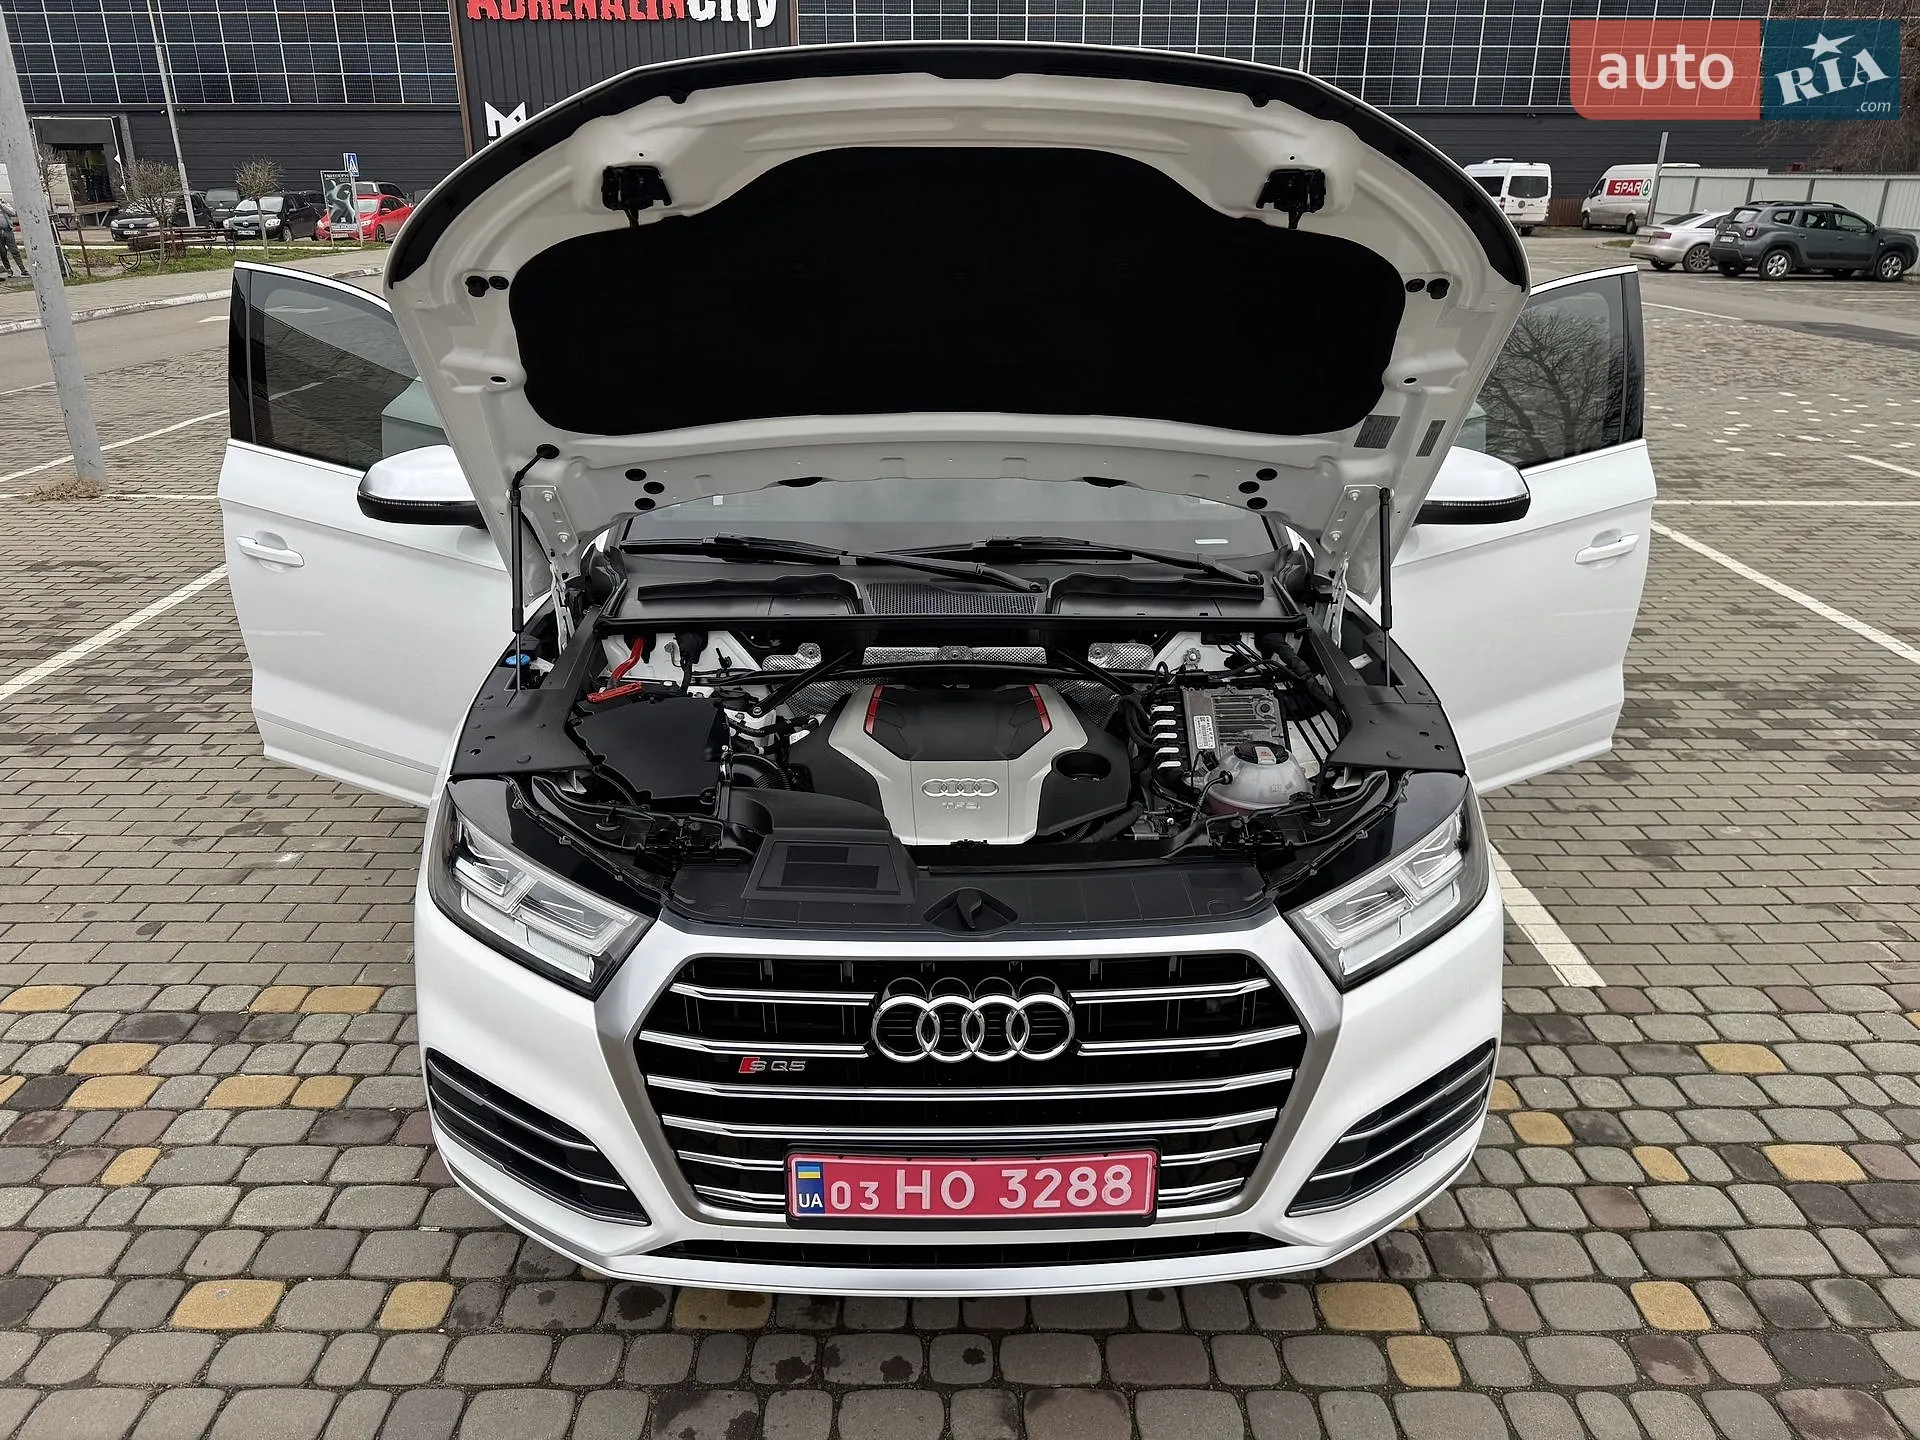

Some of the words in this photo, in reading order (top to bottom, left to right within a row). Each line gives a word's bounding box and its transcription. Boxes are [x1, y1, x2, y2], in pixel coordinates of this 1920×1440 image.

[1613, 181, 1642, 194] SPAR
[830, 1180, 880, 1211] 03
[896, 1168, 976, 1210] HO
[998, 1165, 1133, 1209] 3288
[798, 1193, 823, 1208] UA
